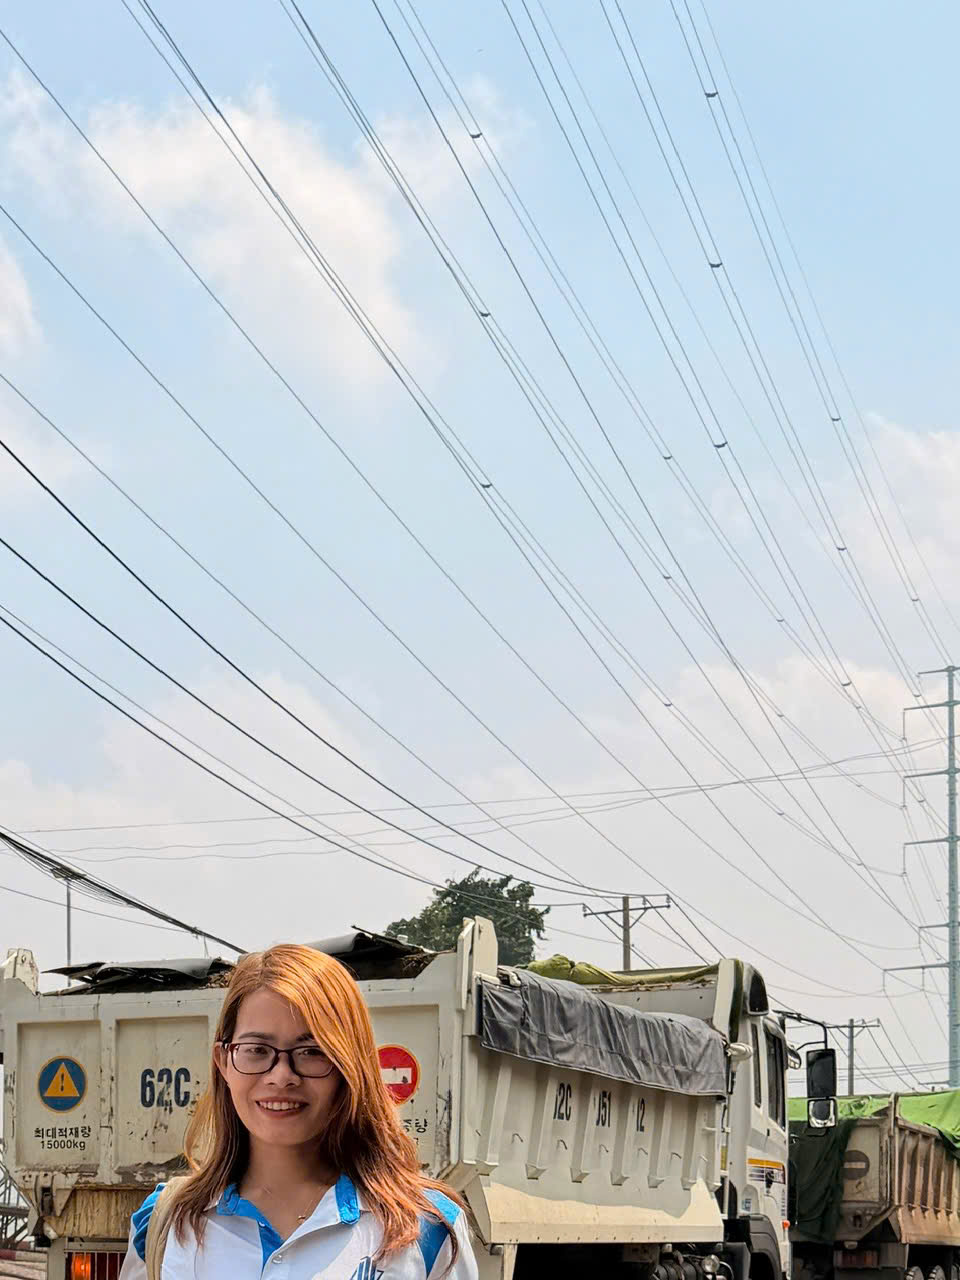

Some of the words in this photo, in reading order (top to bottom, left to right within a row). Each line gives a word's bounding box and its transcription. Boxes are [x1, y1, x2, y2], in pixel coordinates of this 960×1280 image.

[141, 1067, 191, 1107] 62C
[34, 1125, 92, 1139] 최대적재량
[40, 1139, 86, 1151] 15000kg
